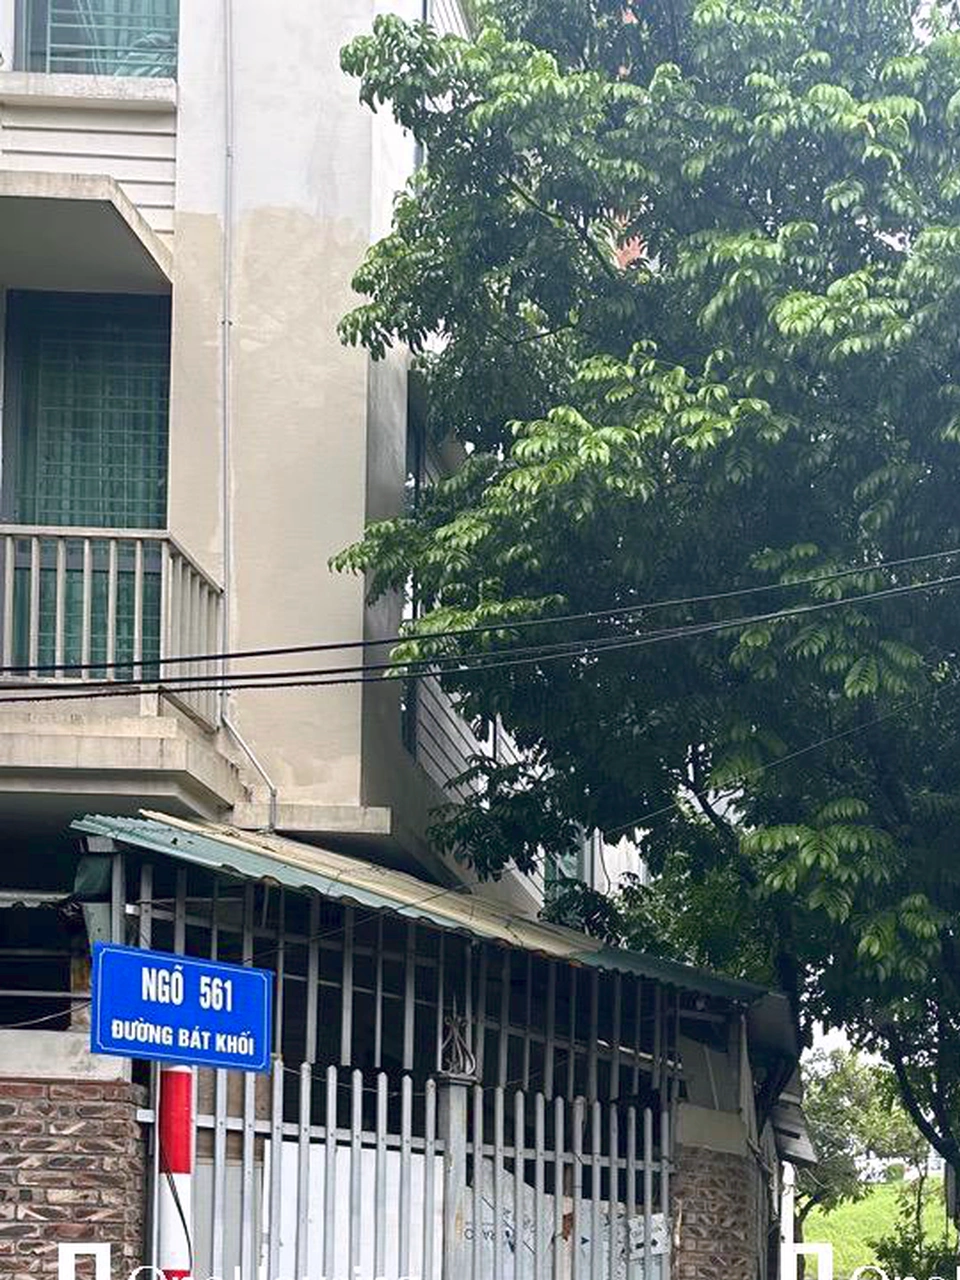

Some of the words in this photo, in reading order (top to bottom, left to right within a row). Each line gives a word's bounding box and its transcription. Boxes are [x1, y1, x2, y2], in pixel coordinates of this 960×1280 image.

[141, 965, 184, 1006] NGÕ
[199, 975, 233, 1012] 561
[111, 1017, 173, 1046] ĐƯỜNG
[178, 1026, 211, 1051] BÁT
[215, 1030, 254, 1056] KHỐI
